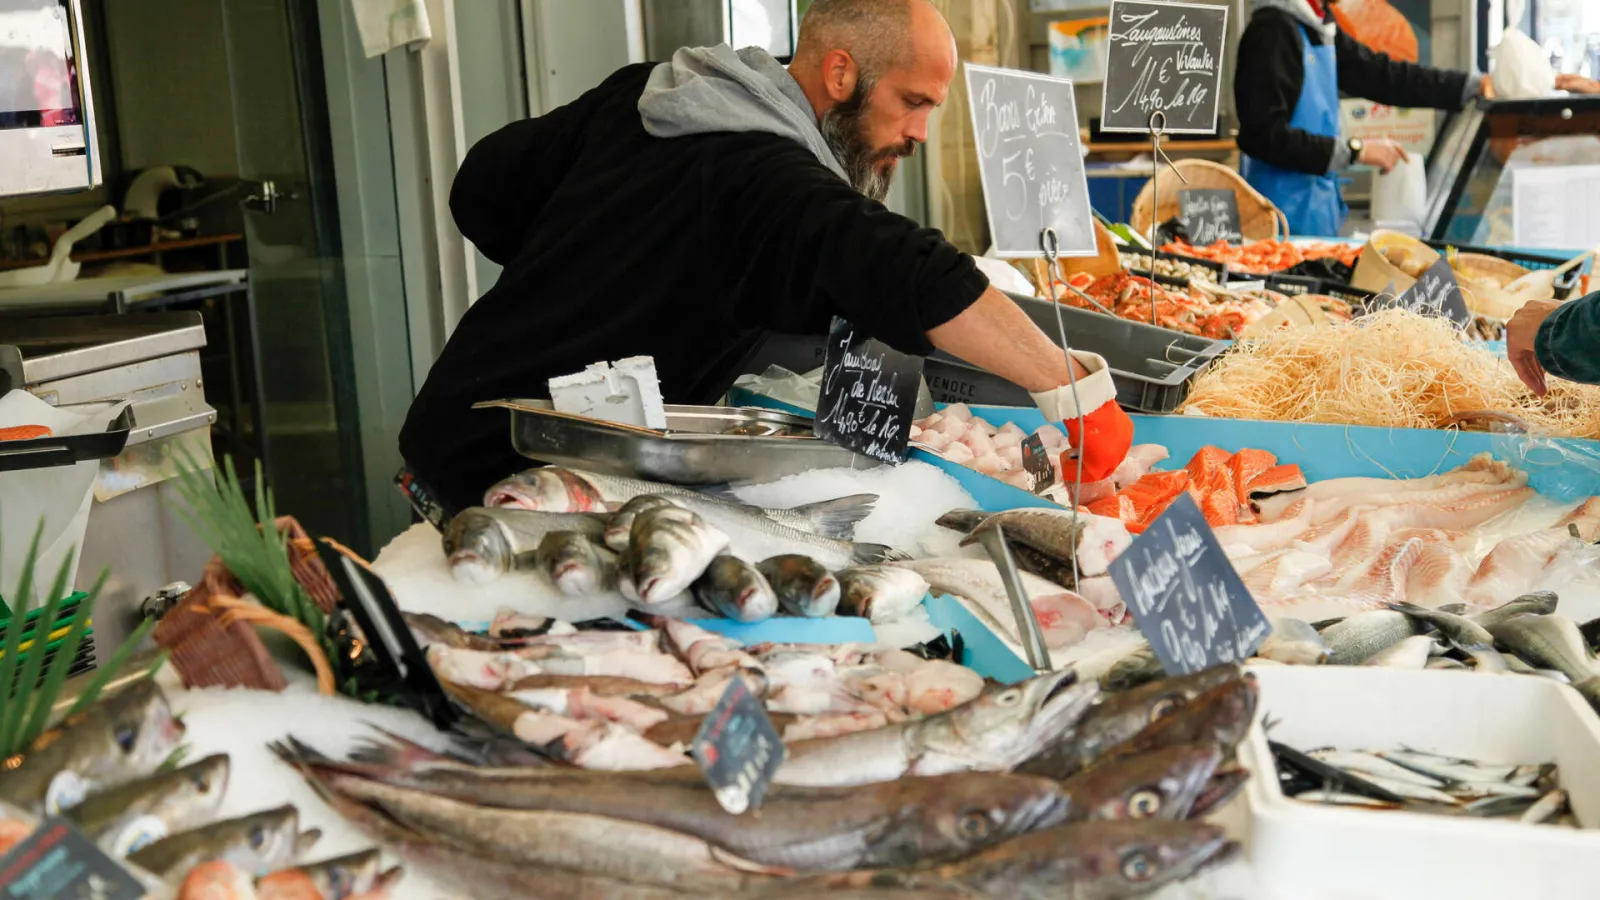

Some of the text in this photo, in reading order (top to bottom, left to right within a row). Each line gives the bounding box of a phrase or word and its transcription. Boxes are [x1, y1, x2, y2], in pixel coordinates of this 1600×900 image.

[1158, 57, 1174, 84] €
[1164, 78, 1189, 111] le
[850, 371, 865, 398] de
[925, 374, 978, 398] VENDEE
[820, 387, 858, 435] 14,90
[862, 409, 880, 436] le
